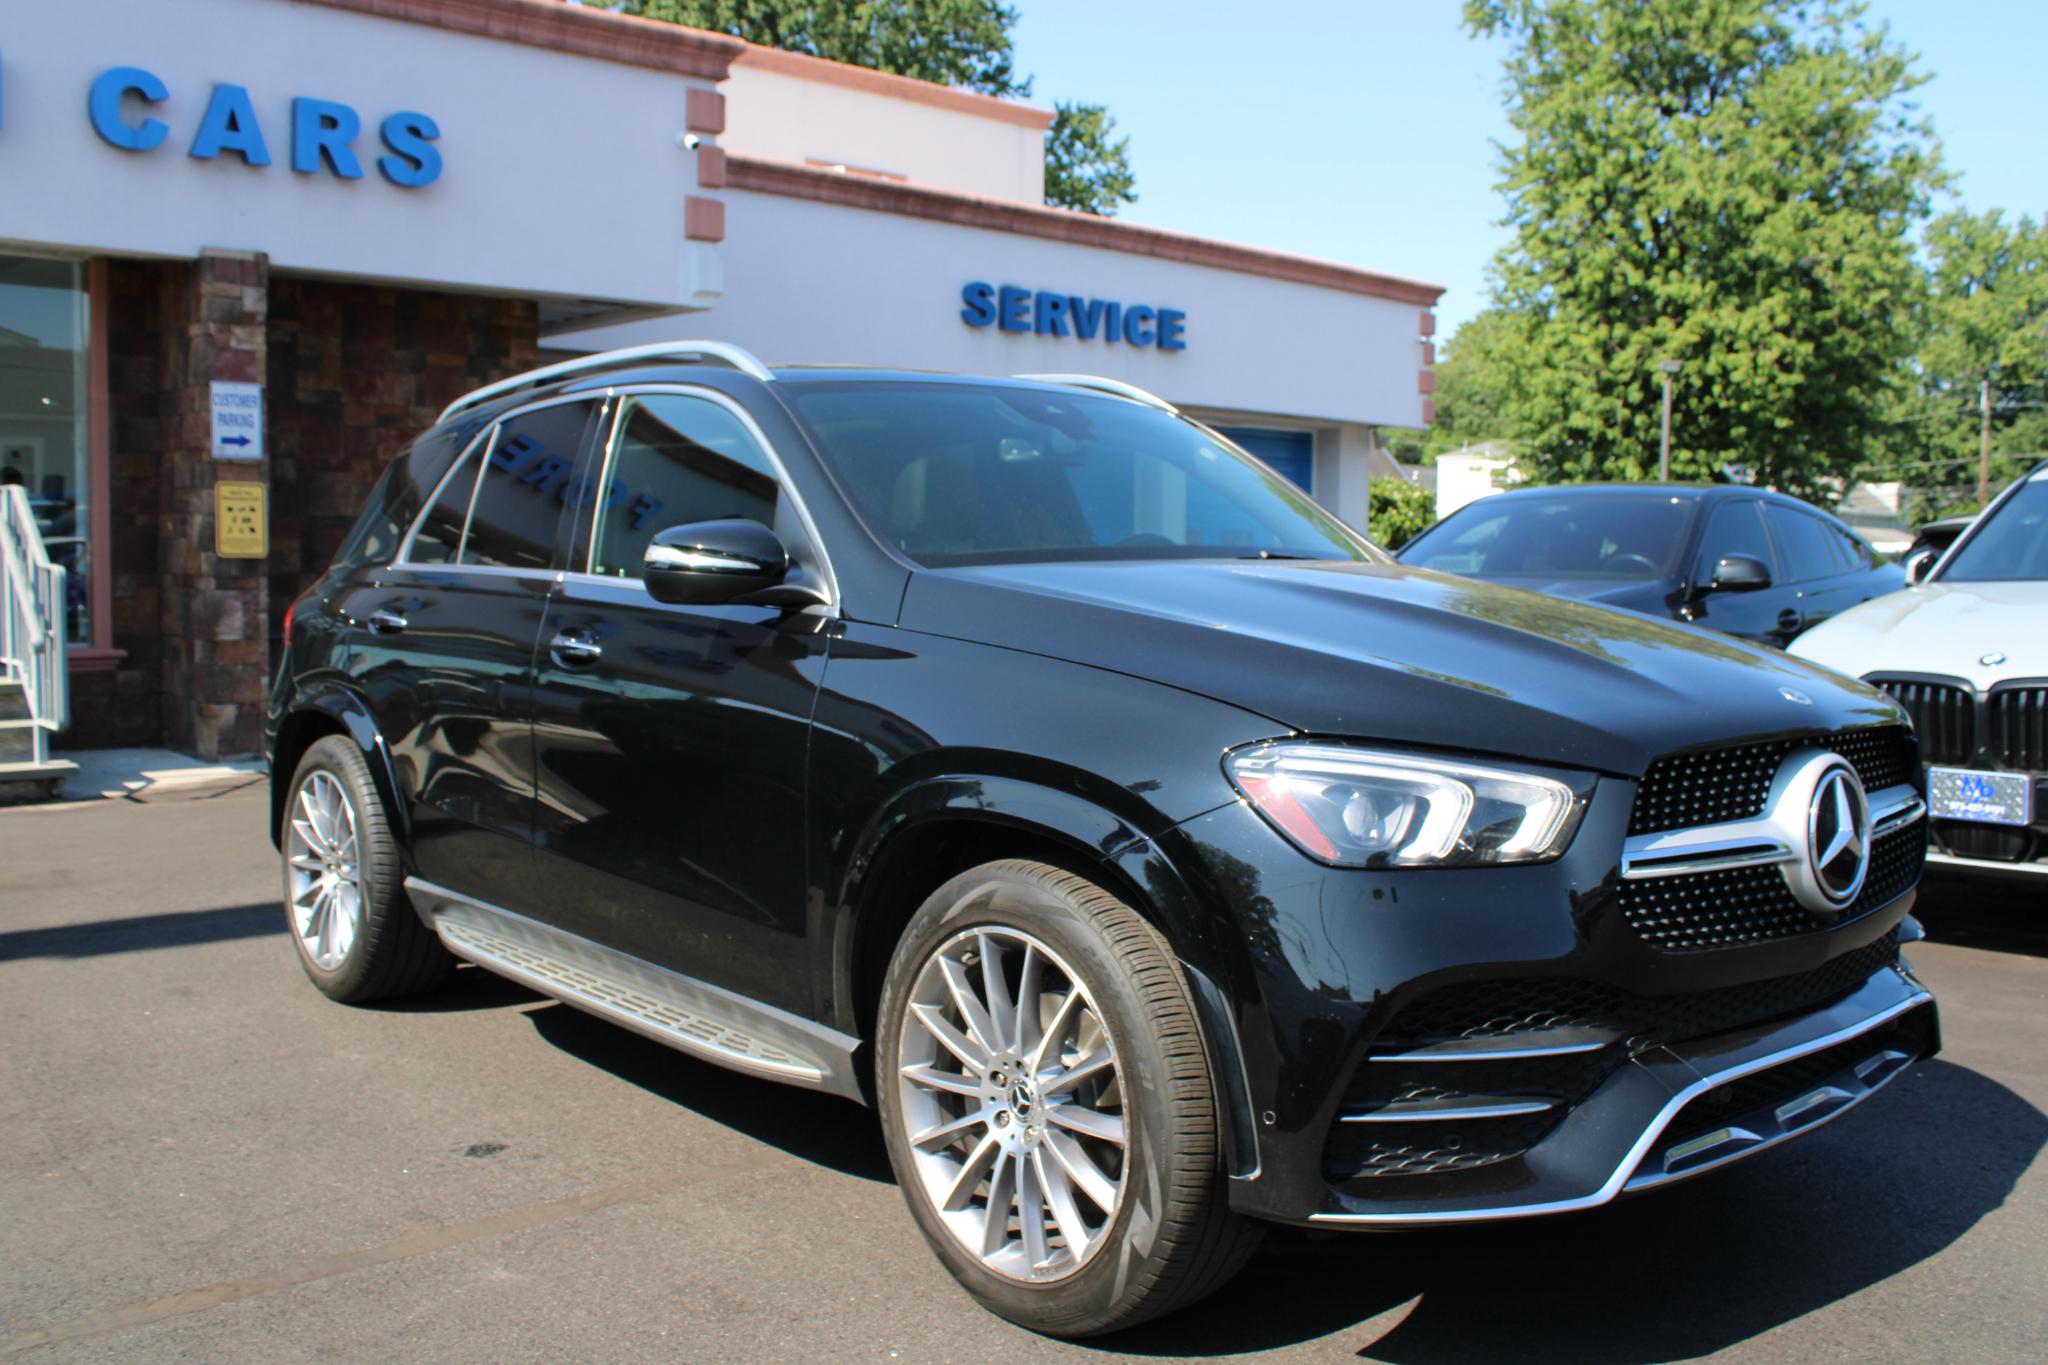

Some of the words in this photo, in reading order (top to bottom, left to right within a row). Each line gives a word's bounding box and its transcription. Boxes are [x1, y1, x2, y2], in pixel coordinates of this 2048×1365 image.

[89, 66, 442, 188] CARS
[960, 281, 1187, 350] SERVICE
[213, 392, 257, 408] CUSTOMER
[217, 411, 254, 429] PARKING
